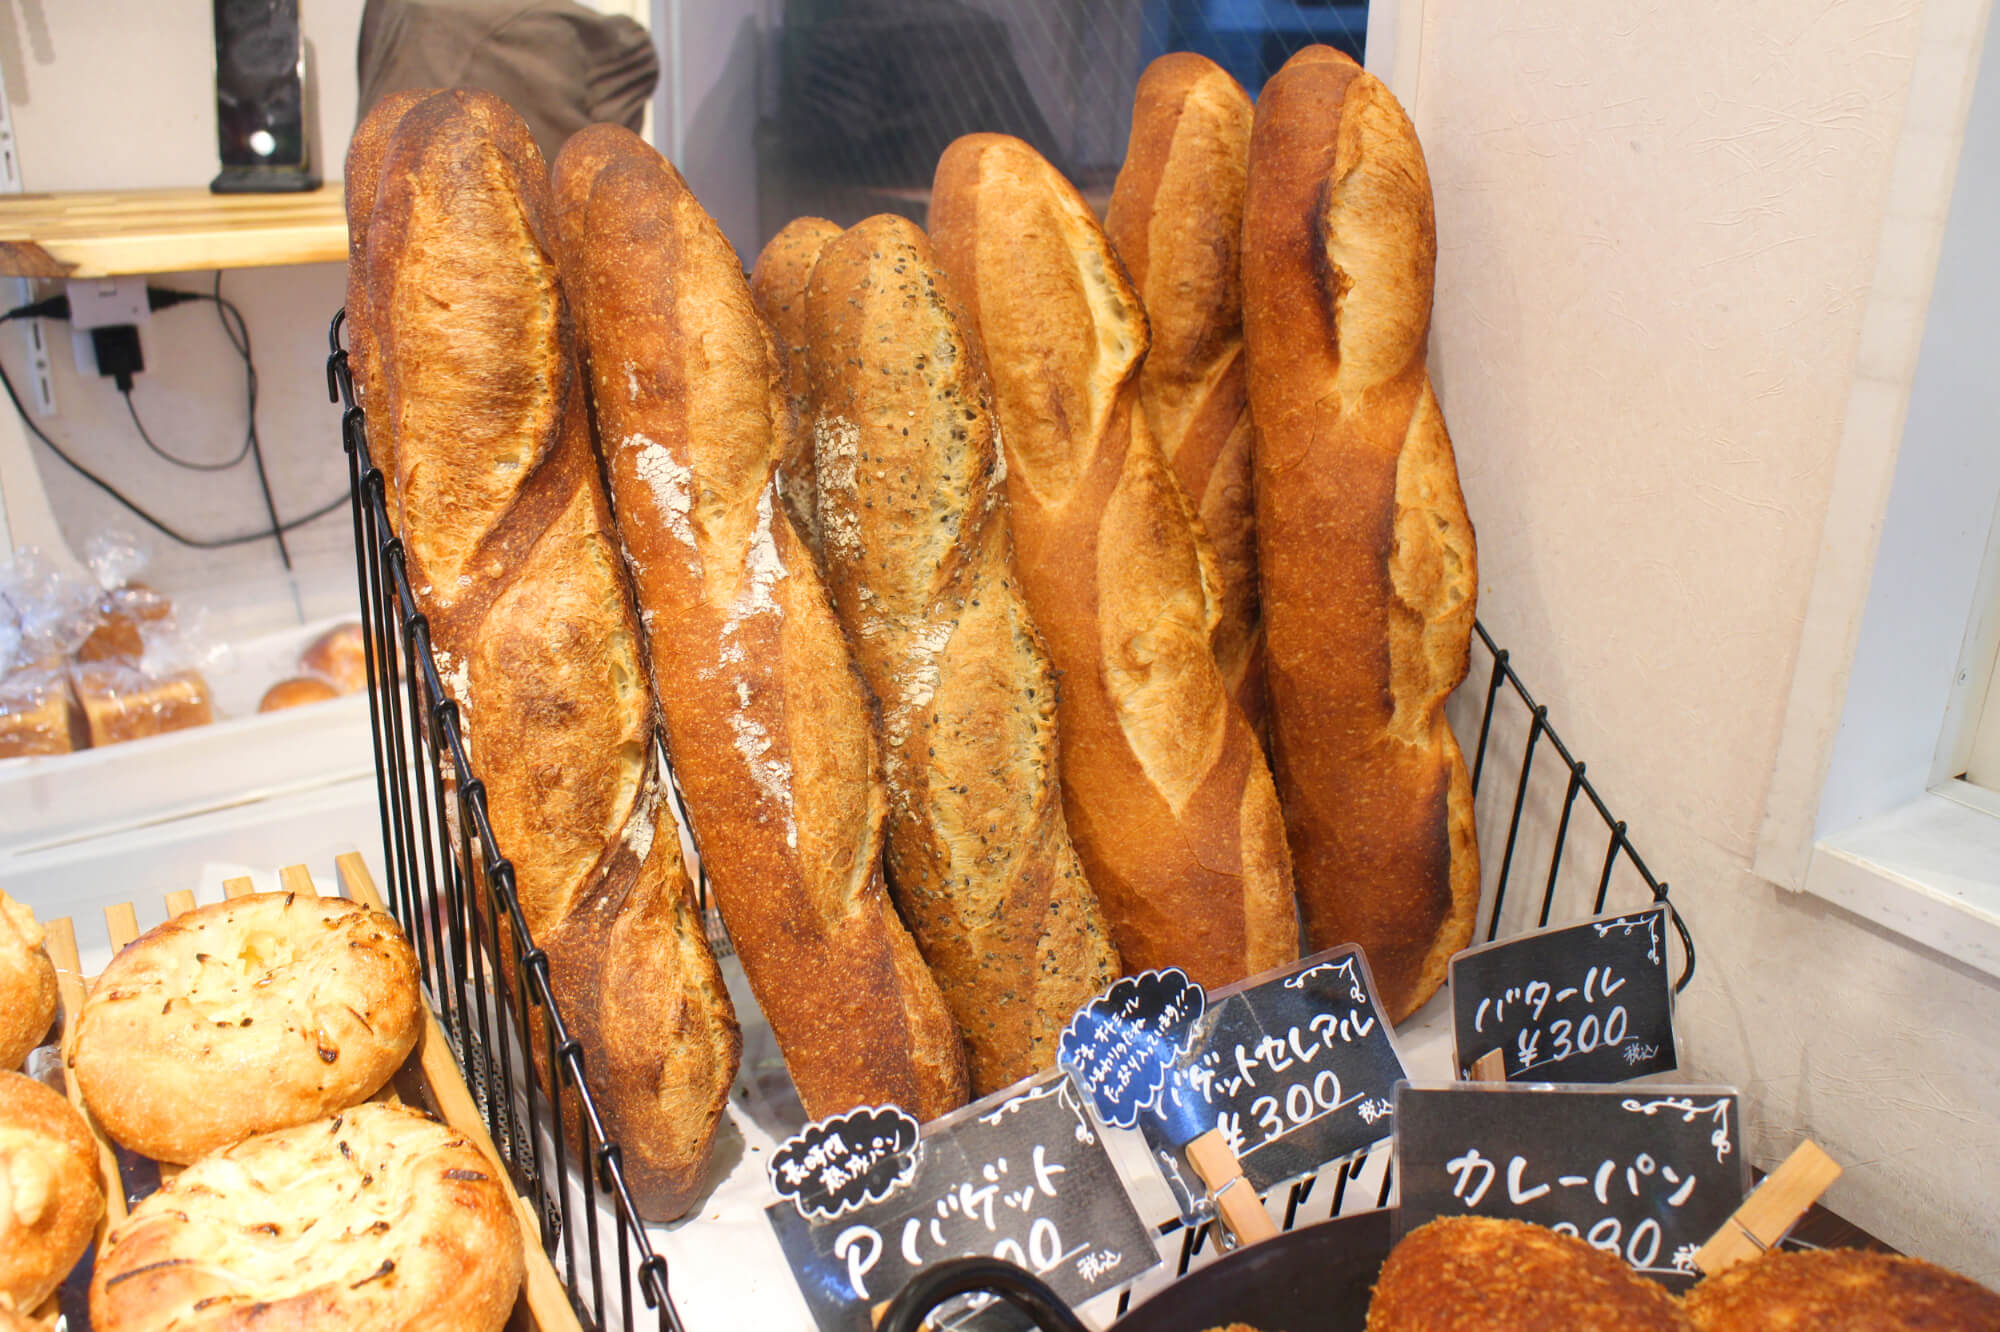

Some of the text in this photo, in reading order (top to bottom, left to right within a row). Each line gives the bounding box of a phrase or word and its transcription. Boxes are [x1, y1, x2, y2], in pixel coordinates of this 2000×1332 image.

[1474, 965, 1627, 1033] バタール
[1086, 1018, 1146, 1093] ひまわりのたね
[1623, 1043, 1659, 1066] 税込
[1357, 1097, 1393, 1126] 税込
[1446, 1149, 1697, 1207] カレーパン
[1076, 1250, 1122, 1284] 税込
